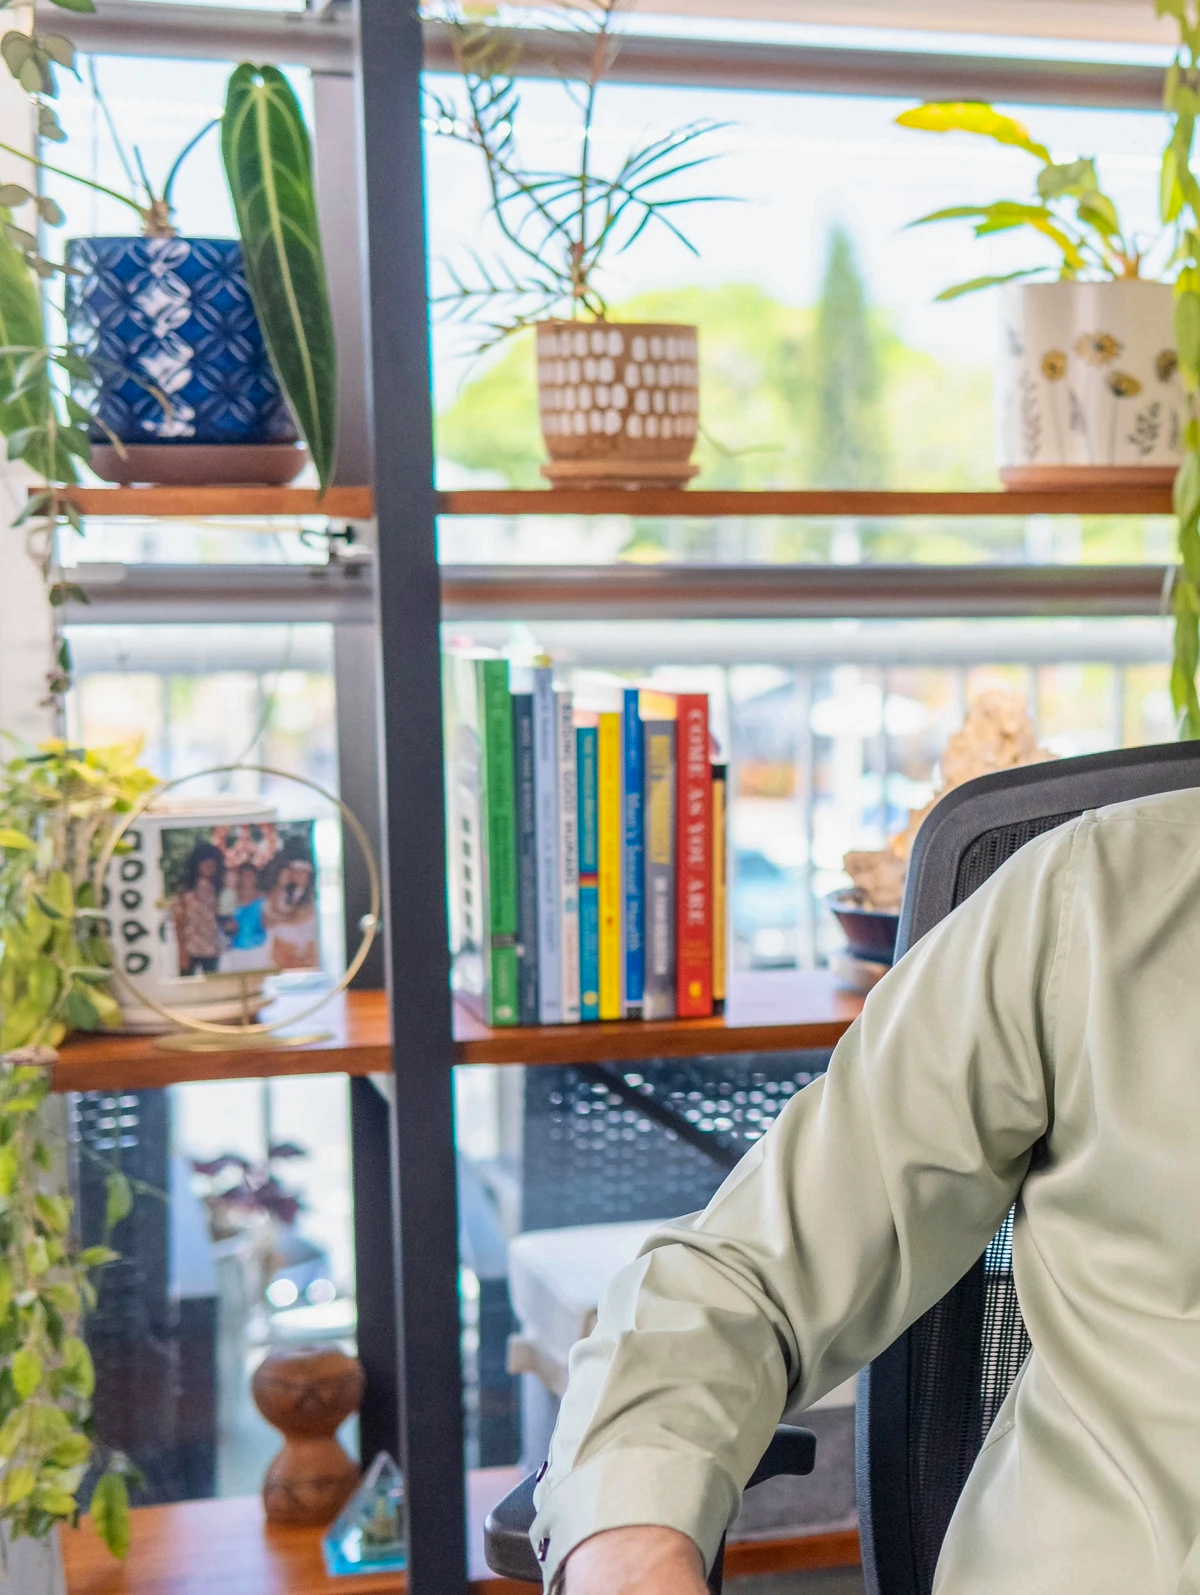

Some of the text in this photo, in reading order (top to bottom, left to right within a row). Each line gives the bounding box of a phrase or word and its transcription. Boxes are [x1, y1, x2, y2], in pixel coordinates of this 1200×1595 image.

[687, 708, 705, 778] COME
[687, 787, 705, 817] AS
[565, 820, 577, 885] HUMANS
[626, 793, 642, 952] Men's Sexual Health
[687, 822, 705, 872] YOU
[687, 878, 705, 926] ARE
